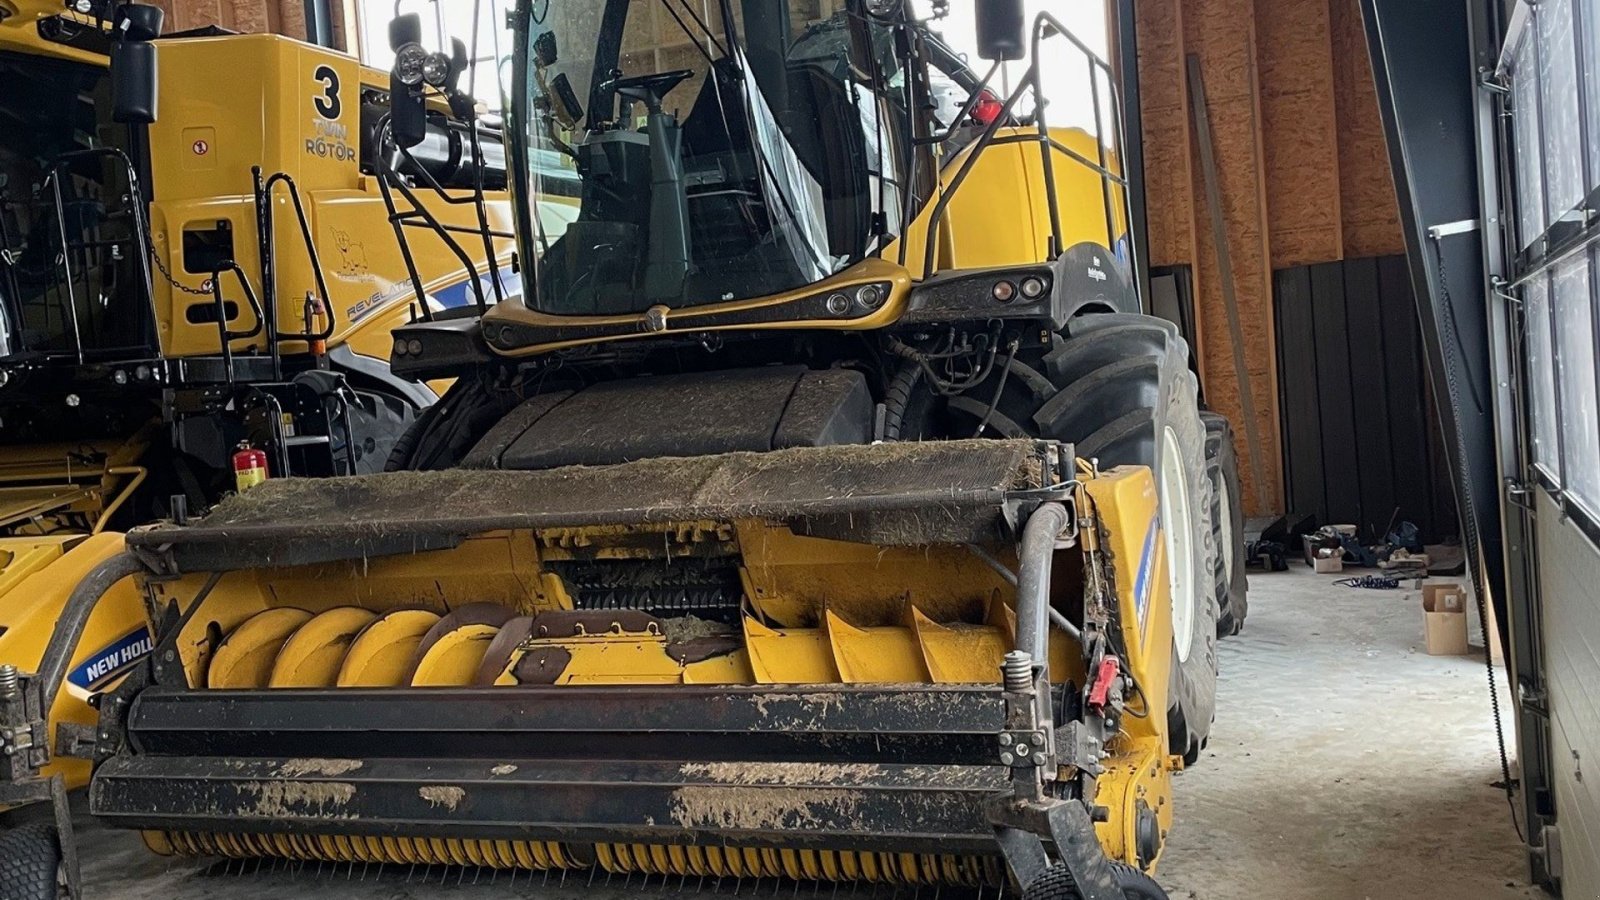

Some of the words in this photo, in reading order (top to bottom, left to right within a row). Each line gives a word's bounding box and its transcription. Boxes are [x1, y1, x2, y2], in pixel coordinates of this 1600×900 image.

[312, 63, 342, 122] 3
[312, 119, 346, 140] TWIN
[305, 136, 356, 163] ROTOR
[346, 274, 422, 318] REVELATIO
[86, 651, 120, 682] NEW
